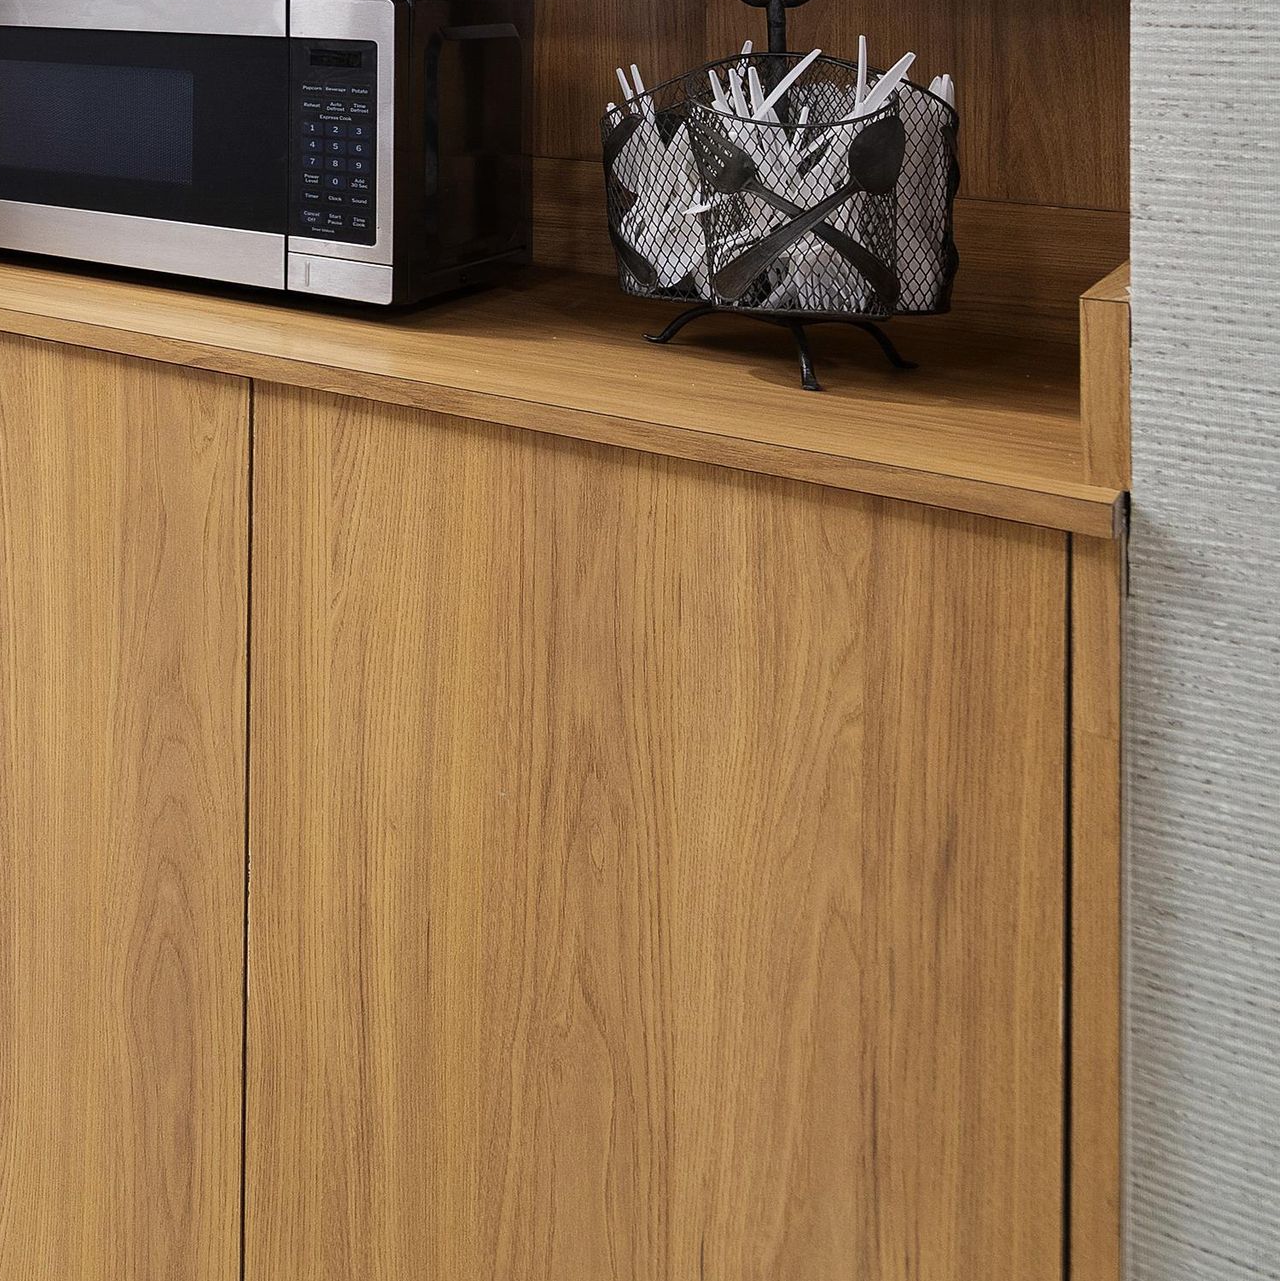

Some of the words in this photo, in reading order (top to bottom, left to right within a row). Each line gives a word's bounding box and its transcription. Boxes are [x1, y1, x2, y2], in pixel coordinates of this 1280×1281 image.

[355, 127, 362, 135] 3
[332, 142, 339, 150] 5
[355, 144, 362, 152] 6
[309, 157, 316, 165] 7
